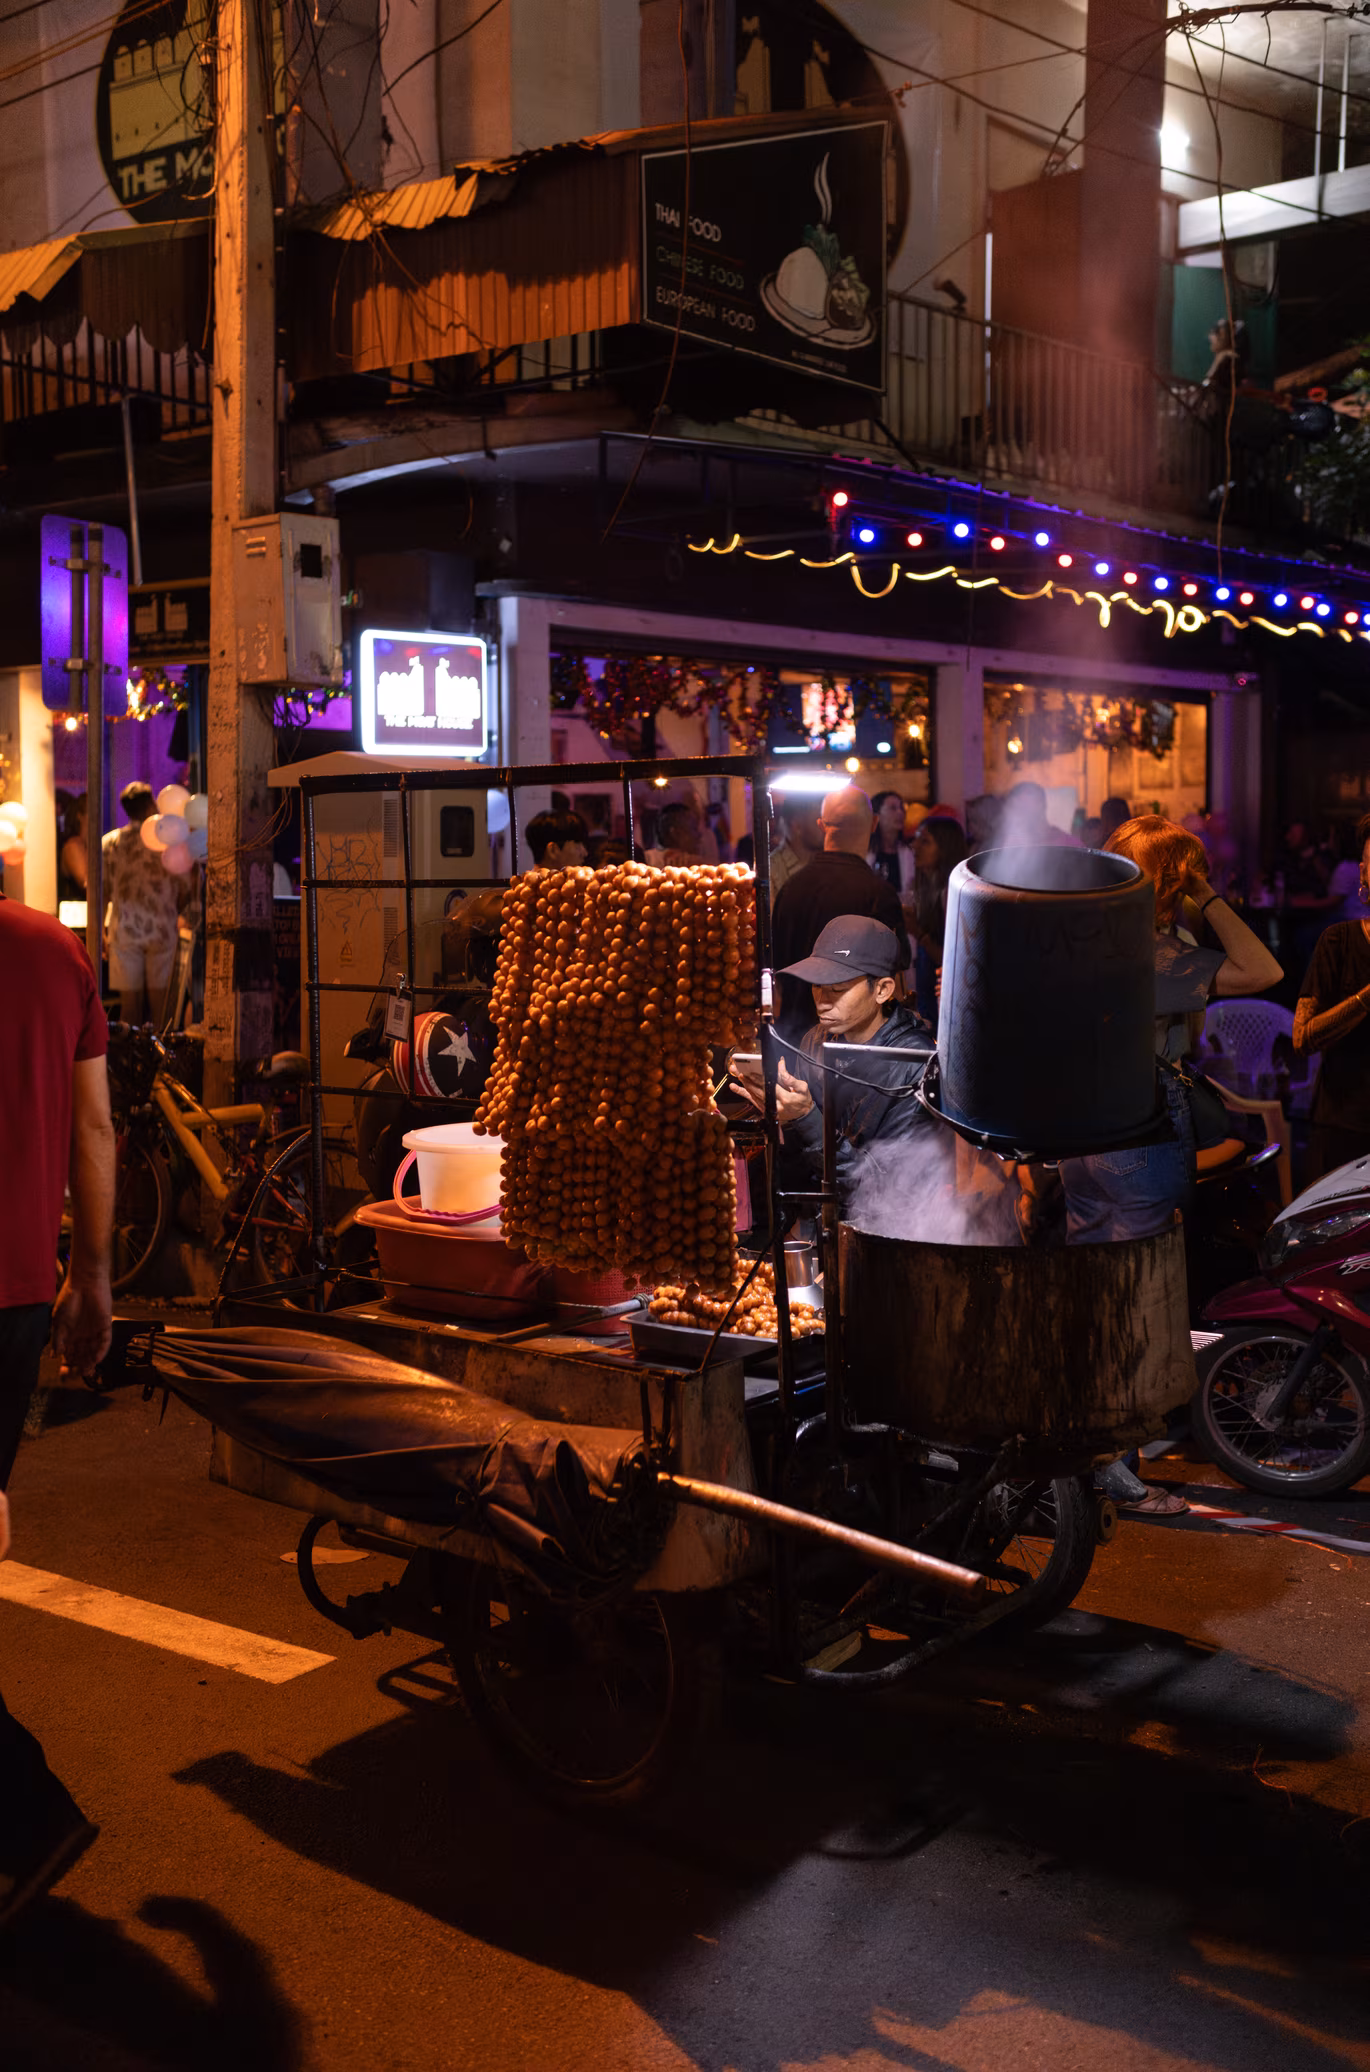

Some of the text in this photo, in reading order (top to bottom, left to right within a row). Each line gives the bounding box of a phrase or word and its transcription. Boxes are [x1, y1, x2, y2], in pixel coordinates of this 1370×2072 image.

[117, 155, 169, 201] THE
[655, 202, 681, 228] THAI
[709, 265, 745, 290] FOOD
[721, 307, 756, 332] FOOD
